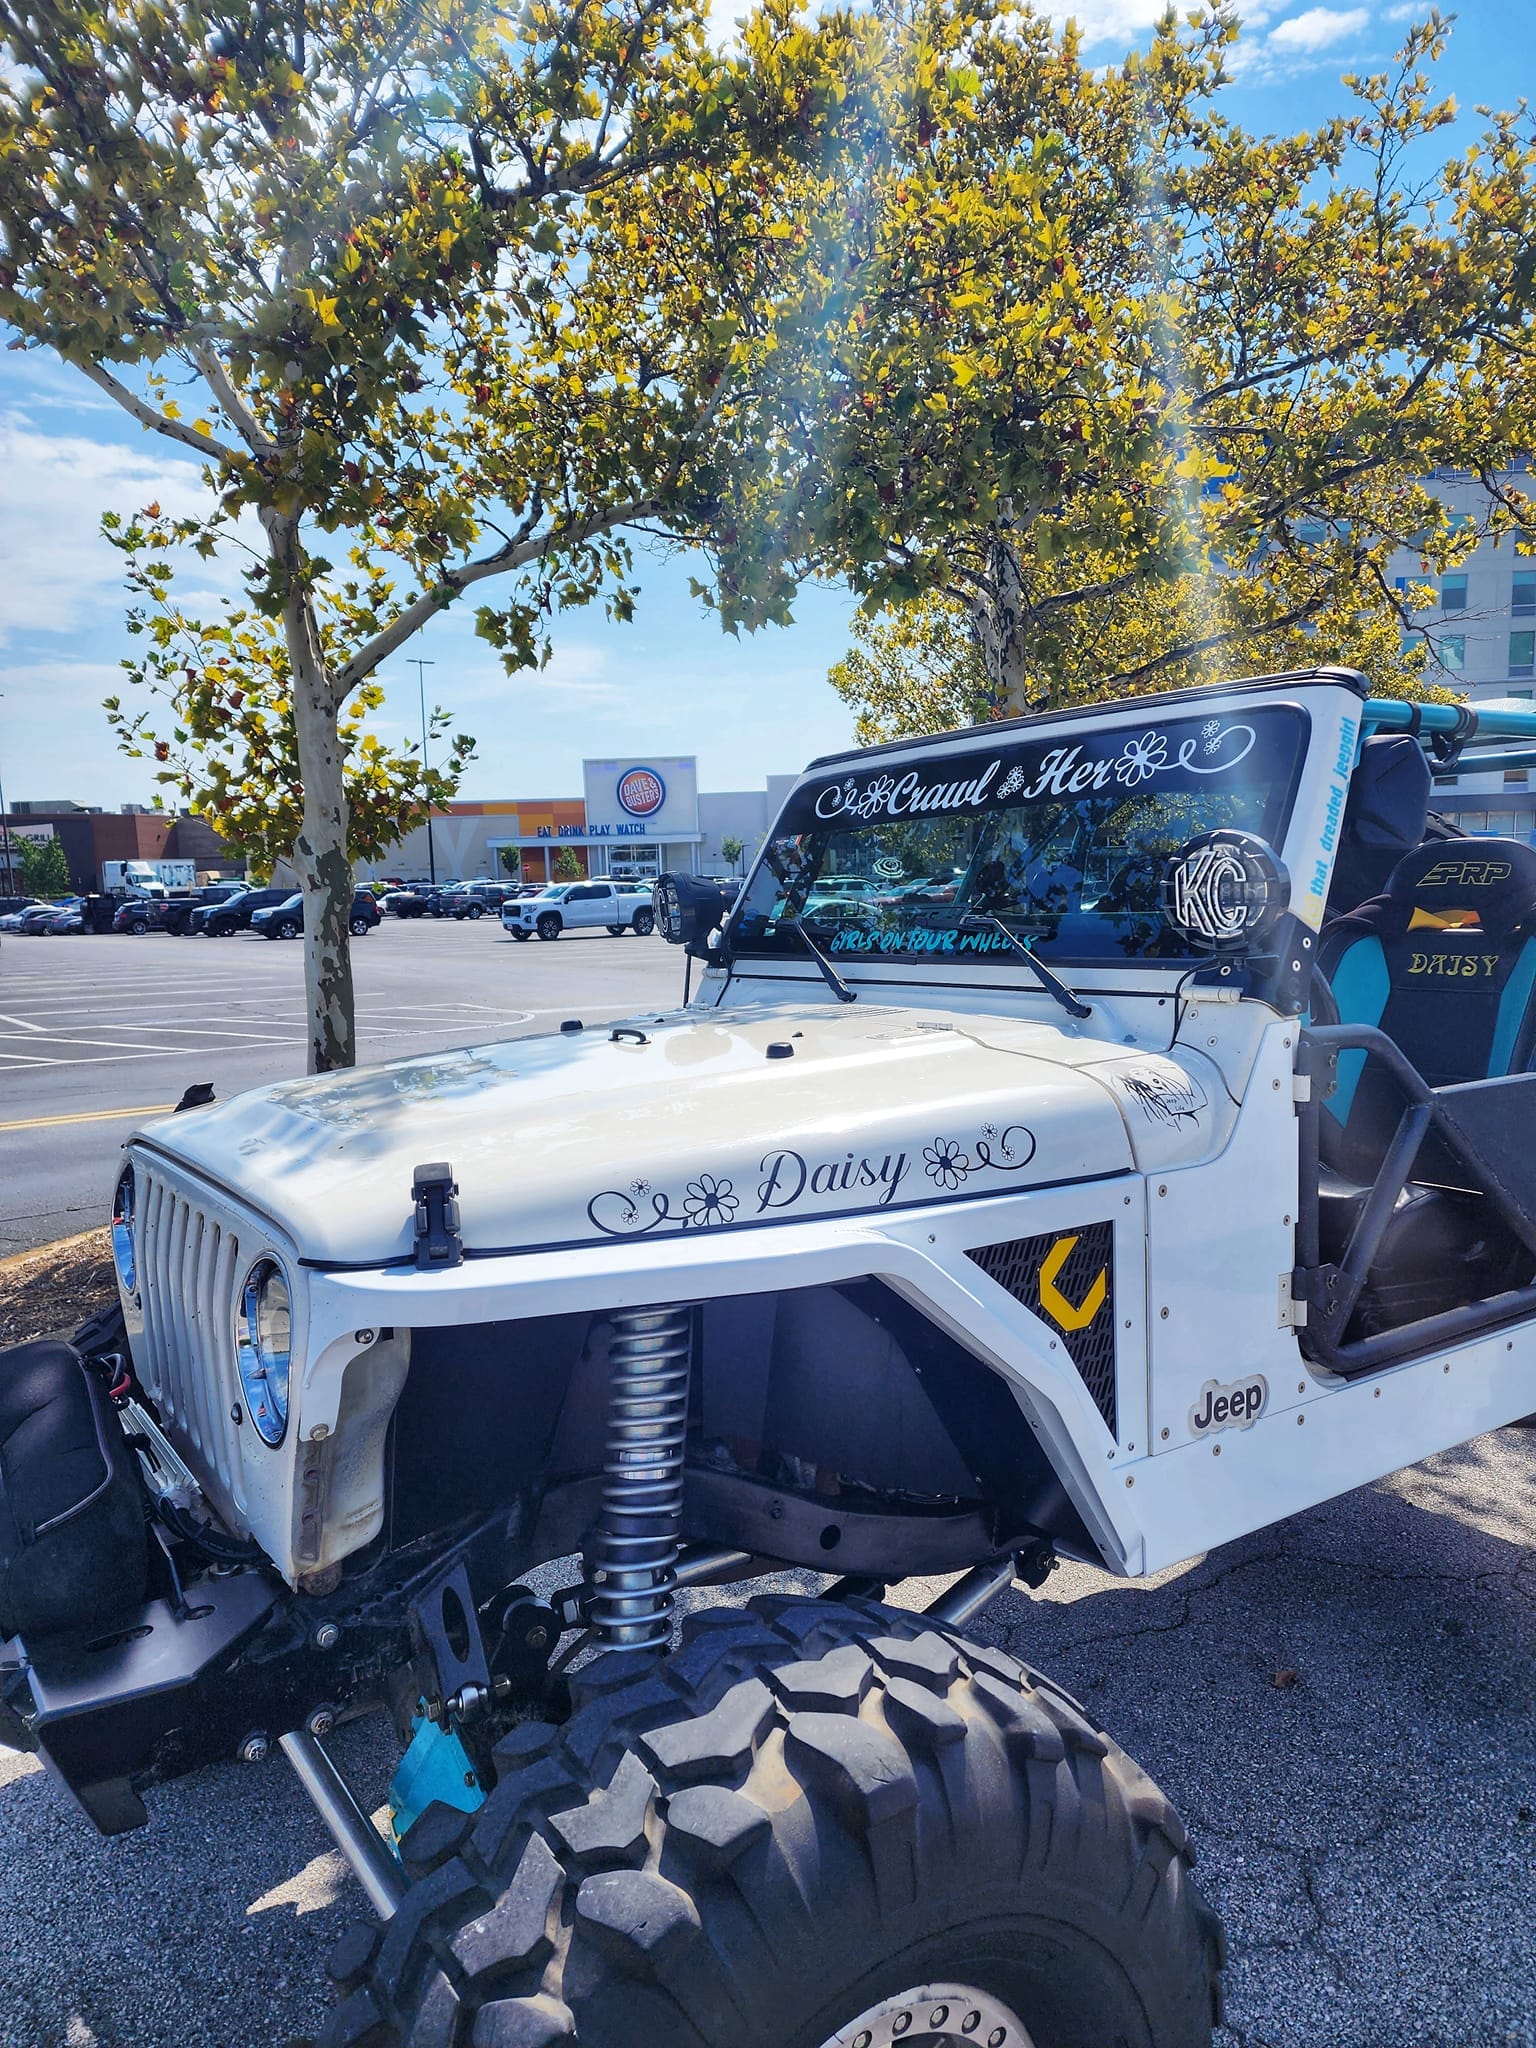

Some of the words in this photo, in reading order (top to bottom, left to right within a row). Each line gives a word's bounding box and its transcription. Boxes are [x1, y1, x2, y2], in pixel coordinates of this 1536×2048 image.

[623, 778, 650, 797] DAVE
[647, 777, 657, 789] &
[886, 759, 1001, 815] Crawl
[1023, 745, 1114, 799] Her
[537, 826, 552, 838] EAT
[558, 825, 585, 837] DRINK
[589, 824, 610, 836] PLAY
[616, 823, 646, 835] WATCH
[1415, 861, 1512, 887] PRP
[1175, 850, 1248, 937] KC
[830, 930, 880, 951] GIRLS
[880, 931, 905, 951] ON
[906, 928, 959, 951] FOUR
[959, 931, 1039, 953] WHEES
[1407, 953, 1500, 977] DAISY
[756, 1149, 912, 1214] Daisy
[1194, 1384, 1262, 1429] Jeep
